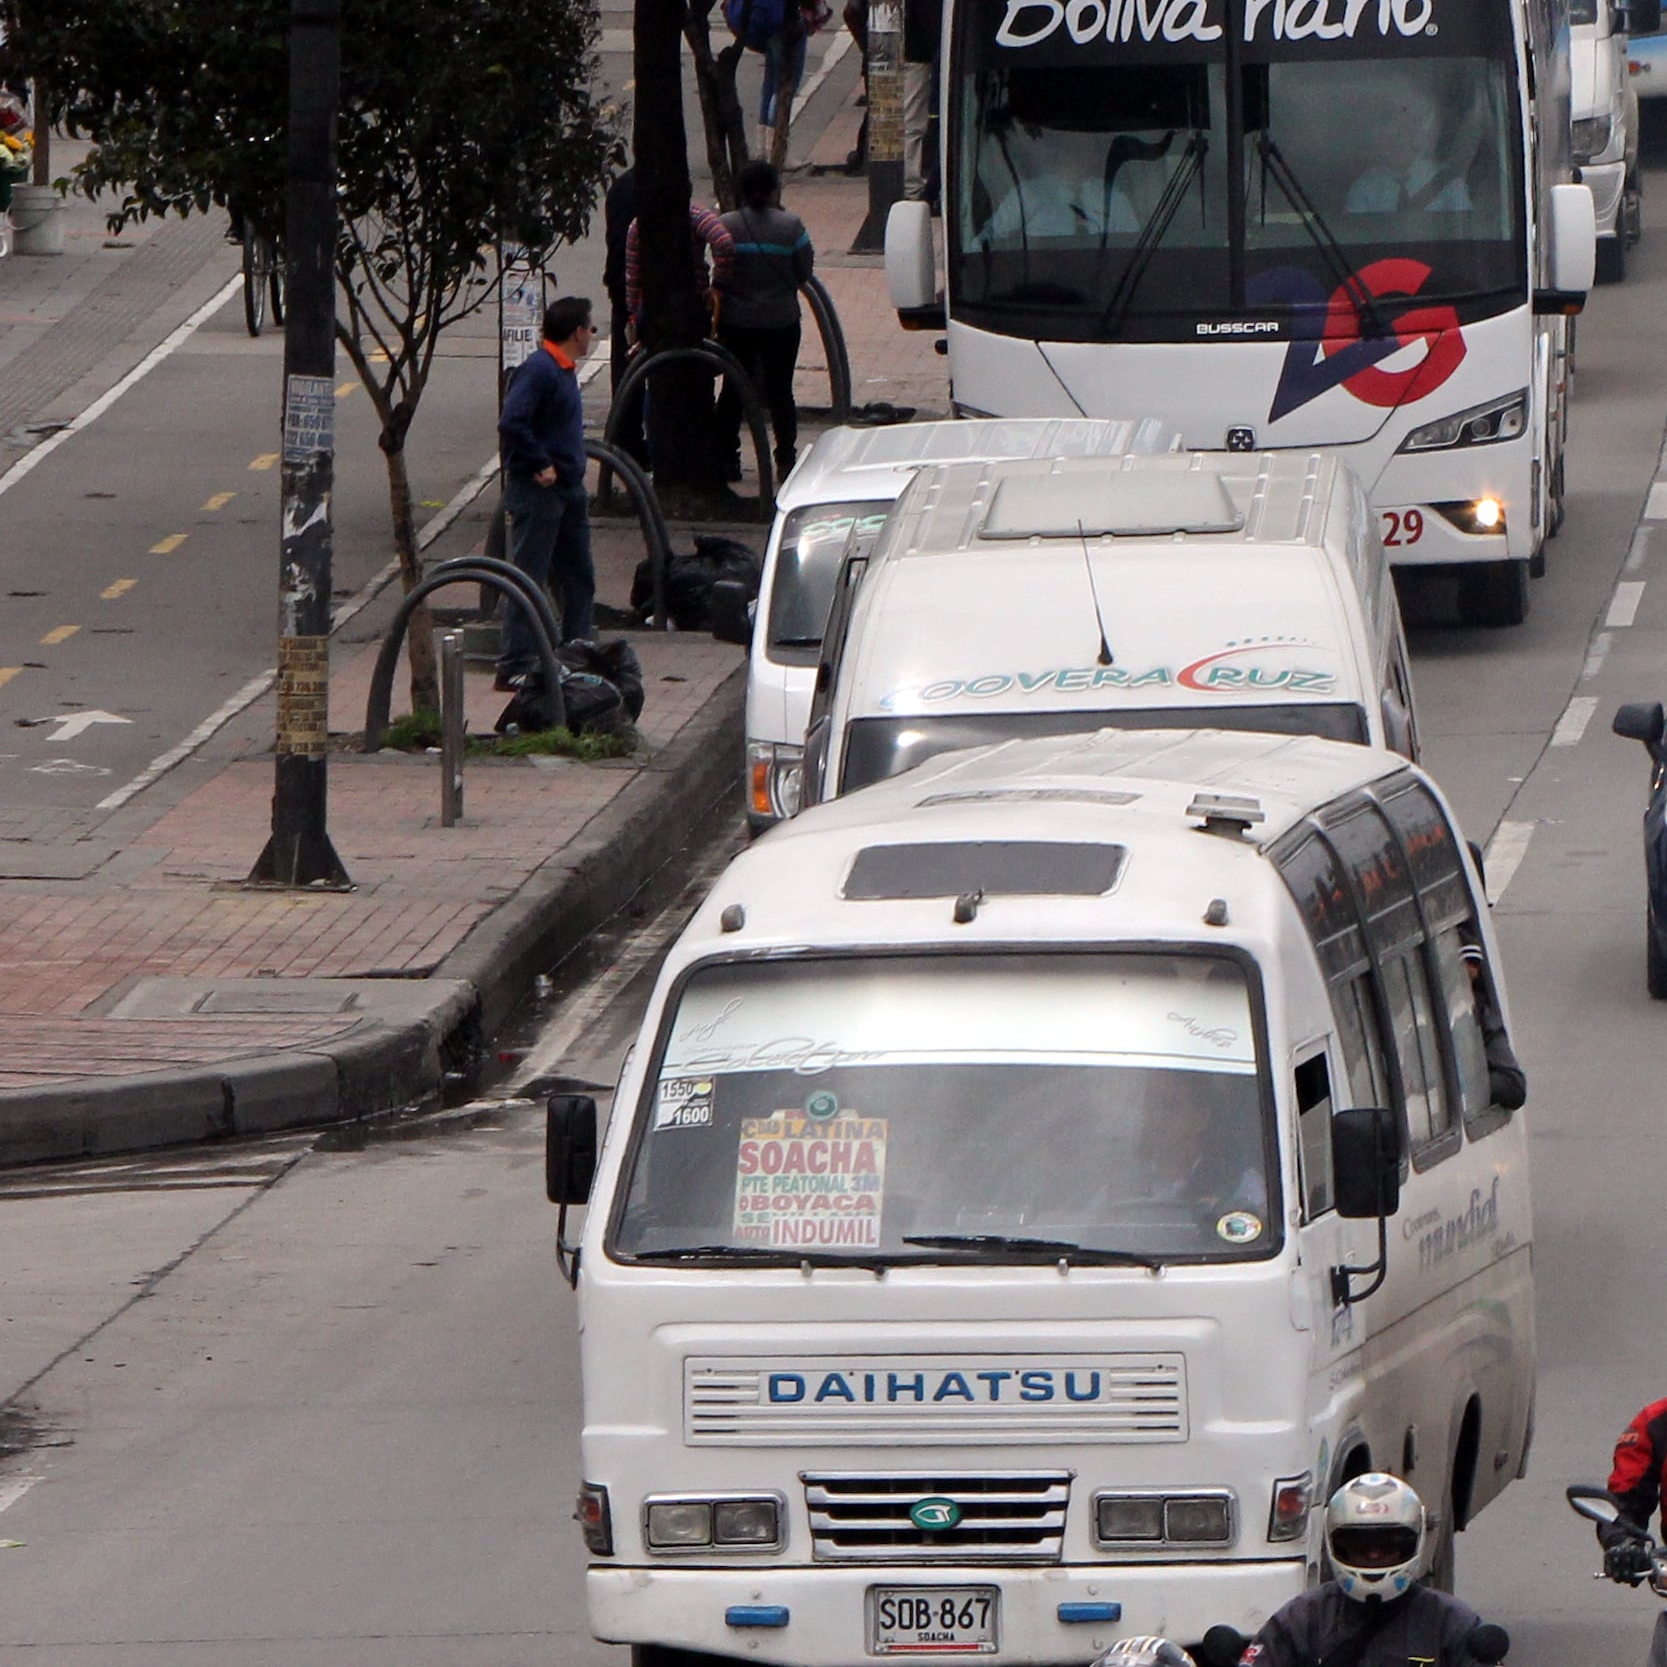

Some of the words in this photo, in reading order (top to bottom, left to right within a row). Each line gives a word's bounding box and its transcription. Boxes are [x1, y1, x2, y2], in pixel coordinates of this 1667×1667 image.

[1196, 322, 1279, 335] BUSSCAR
[1382, 509, 1423, 547] 29
[673, 1106, 709, 1125] 1600
[738, 1140, 877, 1175] SOACHA
[772, 1175, 849, 1193] PEATONAL
[750, 1194, 876, 1211] BOYACA
[773, 1218, 877, 1245] INDUMIL
[768, 1371, 1101, 1402] DAIHATSU
